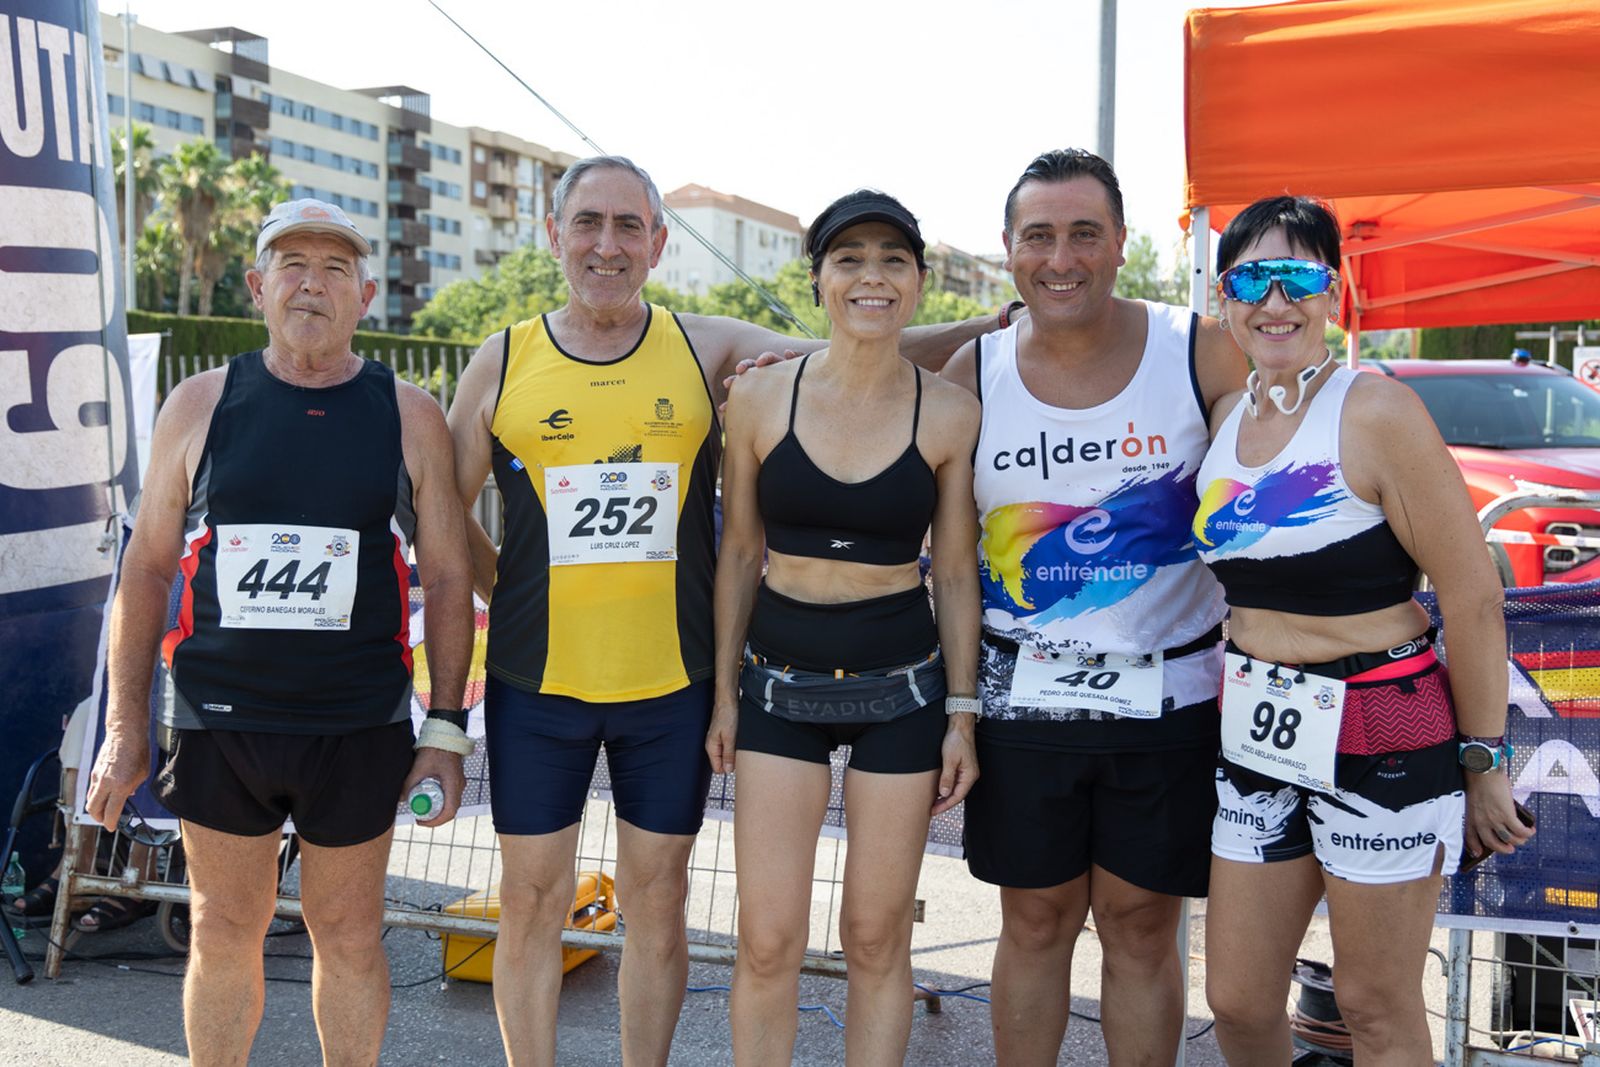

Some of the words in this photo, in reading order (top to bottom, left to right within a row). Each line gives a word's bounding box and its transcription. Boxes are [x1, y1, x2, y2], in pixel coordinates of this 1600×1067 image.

[994, 422, 1167, 480] calderón
[1122, 465, 1147, 474] desde
[1152, 462, 1170, 471] 1949
[568, 496, 658, 538] 252
[1216, 518, 1267, 533] entrénate
[605, 542, 620, 550] CRUZ
[237, 559, 332, 600] 444
[1036, 561, 1149, 582] entrénate
[267, 606, 296, 614] BANEGAS
[298, 607, 326, 615] MORALES
[1054, 670, 1121, 690] 40
[788, 696, 897, 716] EVADICT
[1079, 692, 1109, 701] QUESADA
[1250, 701, 1302, 750] 98
[1278, 756, 1307, 771] CARRASCO
[1331, 827, 1437, 851] entrénate
